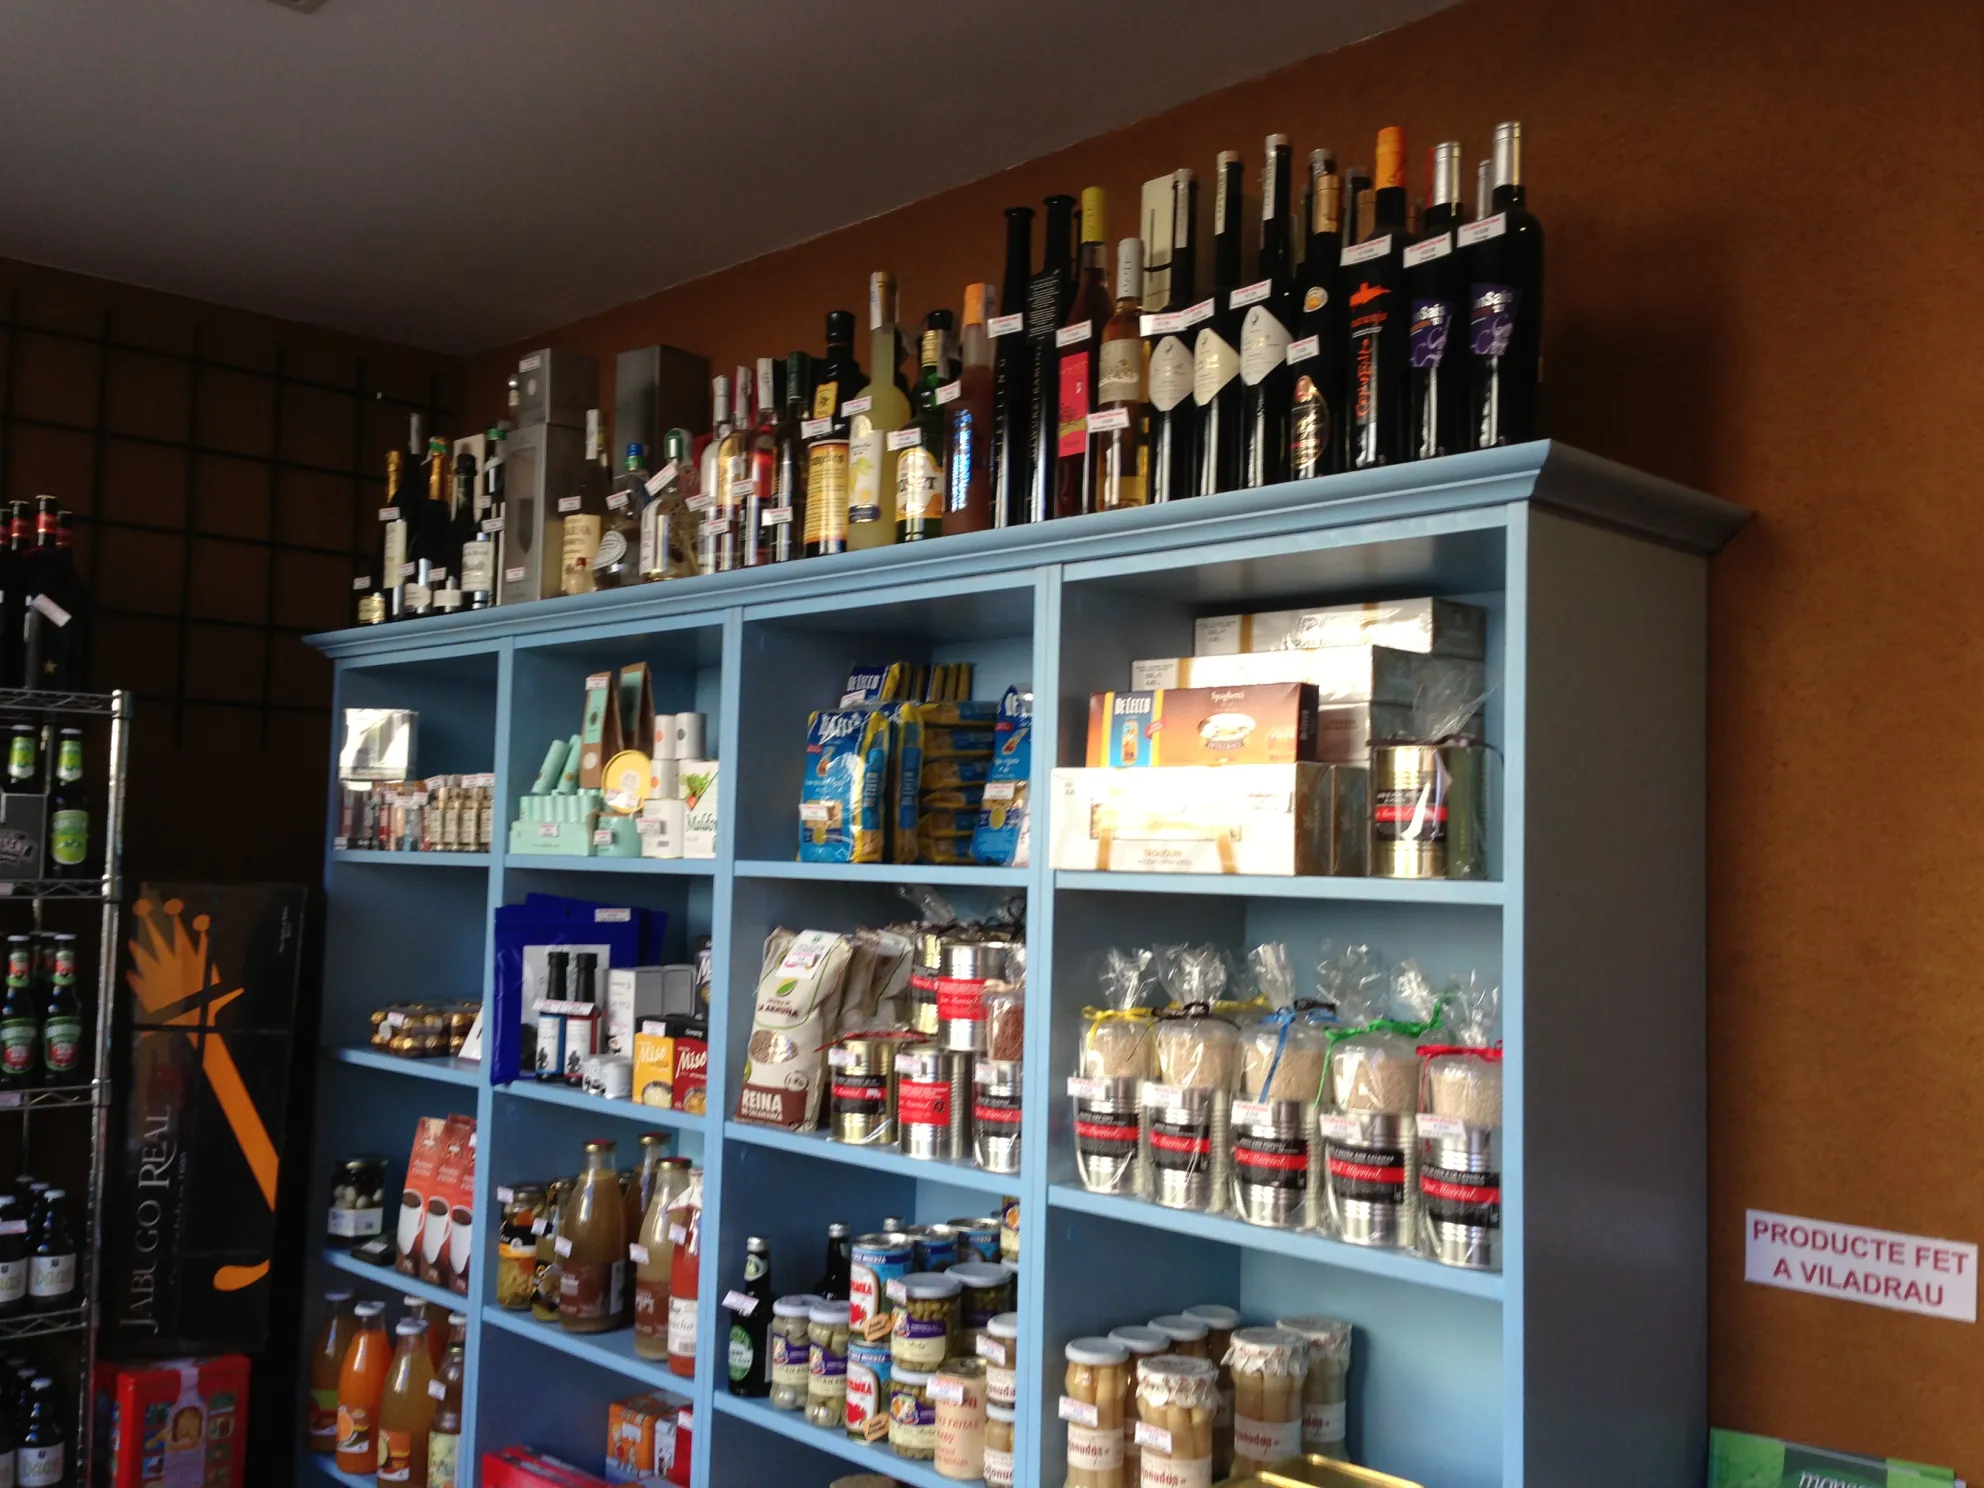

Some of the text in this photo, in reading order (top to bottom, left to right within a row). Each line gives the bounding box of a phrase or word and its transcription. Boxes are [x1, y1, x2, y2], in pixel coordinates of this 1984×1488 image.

[741, 1087, 783, 1113] REINA
[138, 1104, 178, 1188] REAL
[1753, 1219, 1969, 1276] PRODUCTE FET
[1772, 1256, 1944, 1308] A VILADRAU
